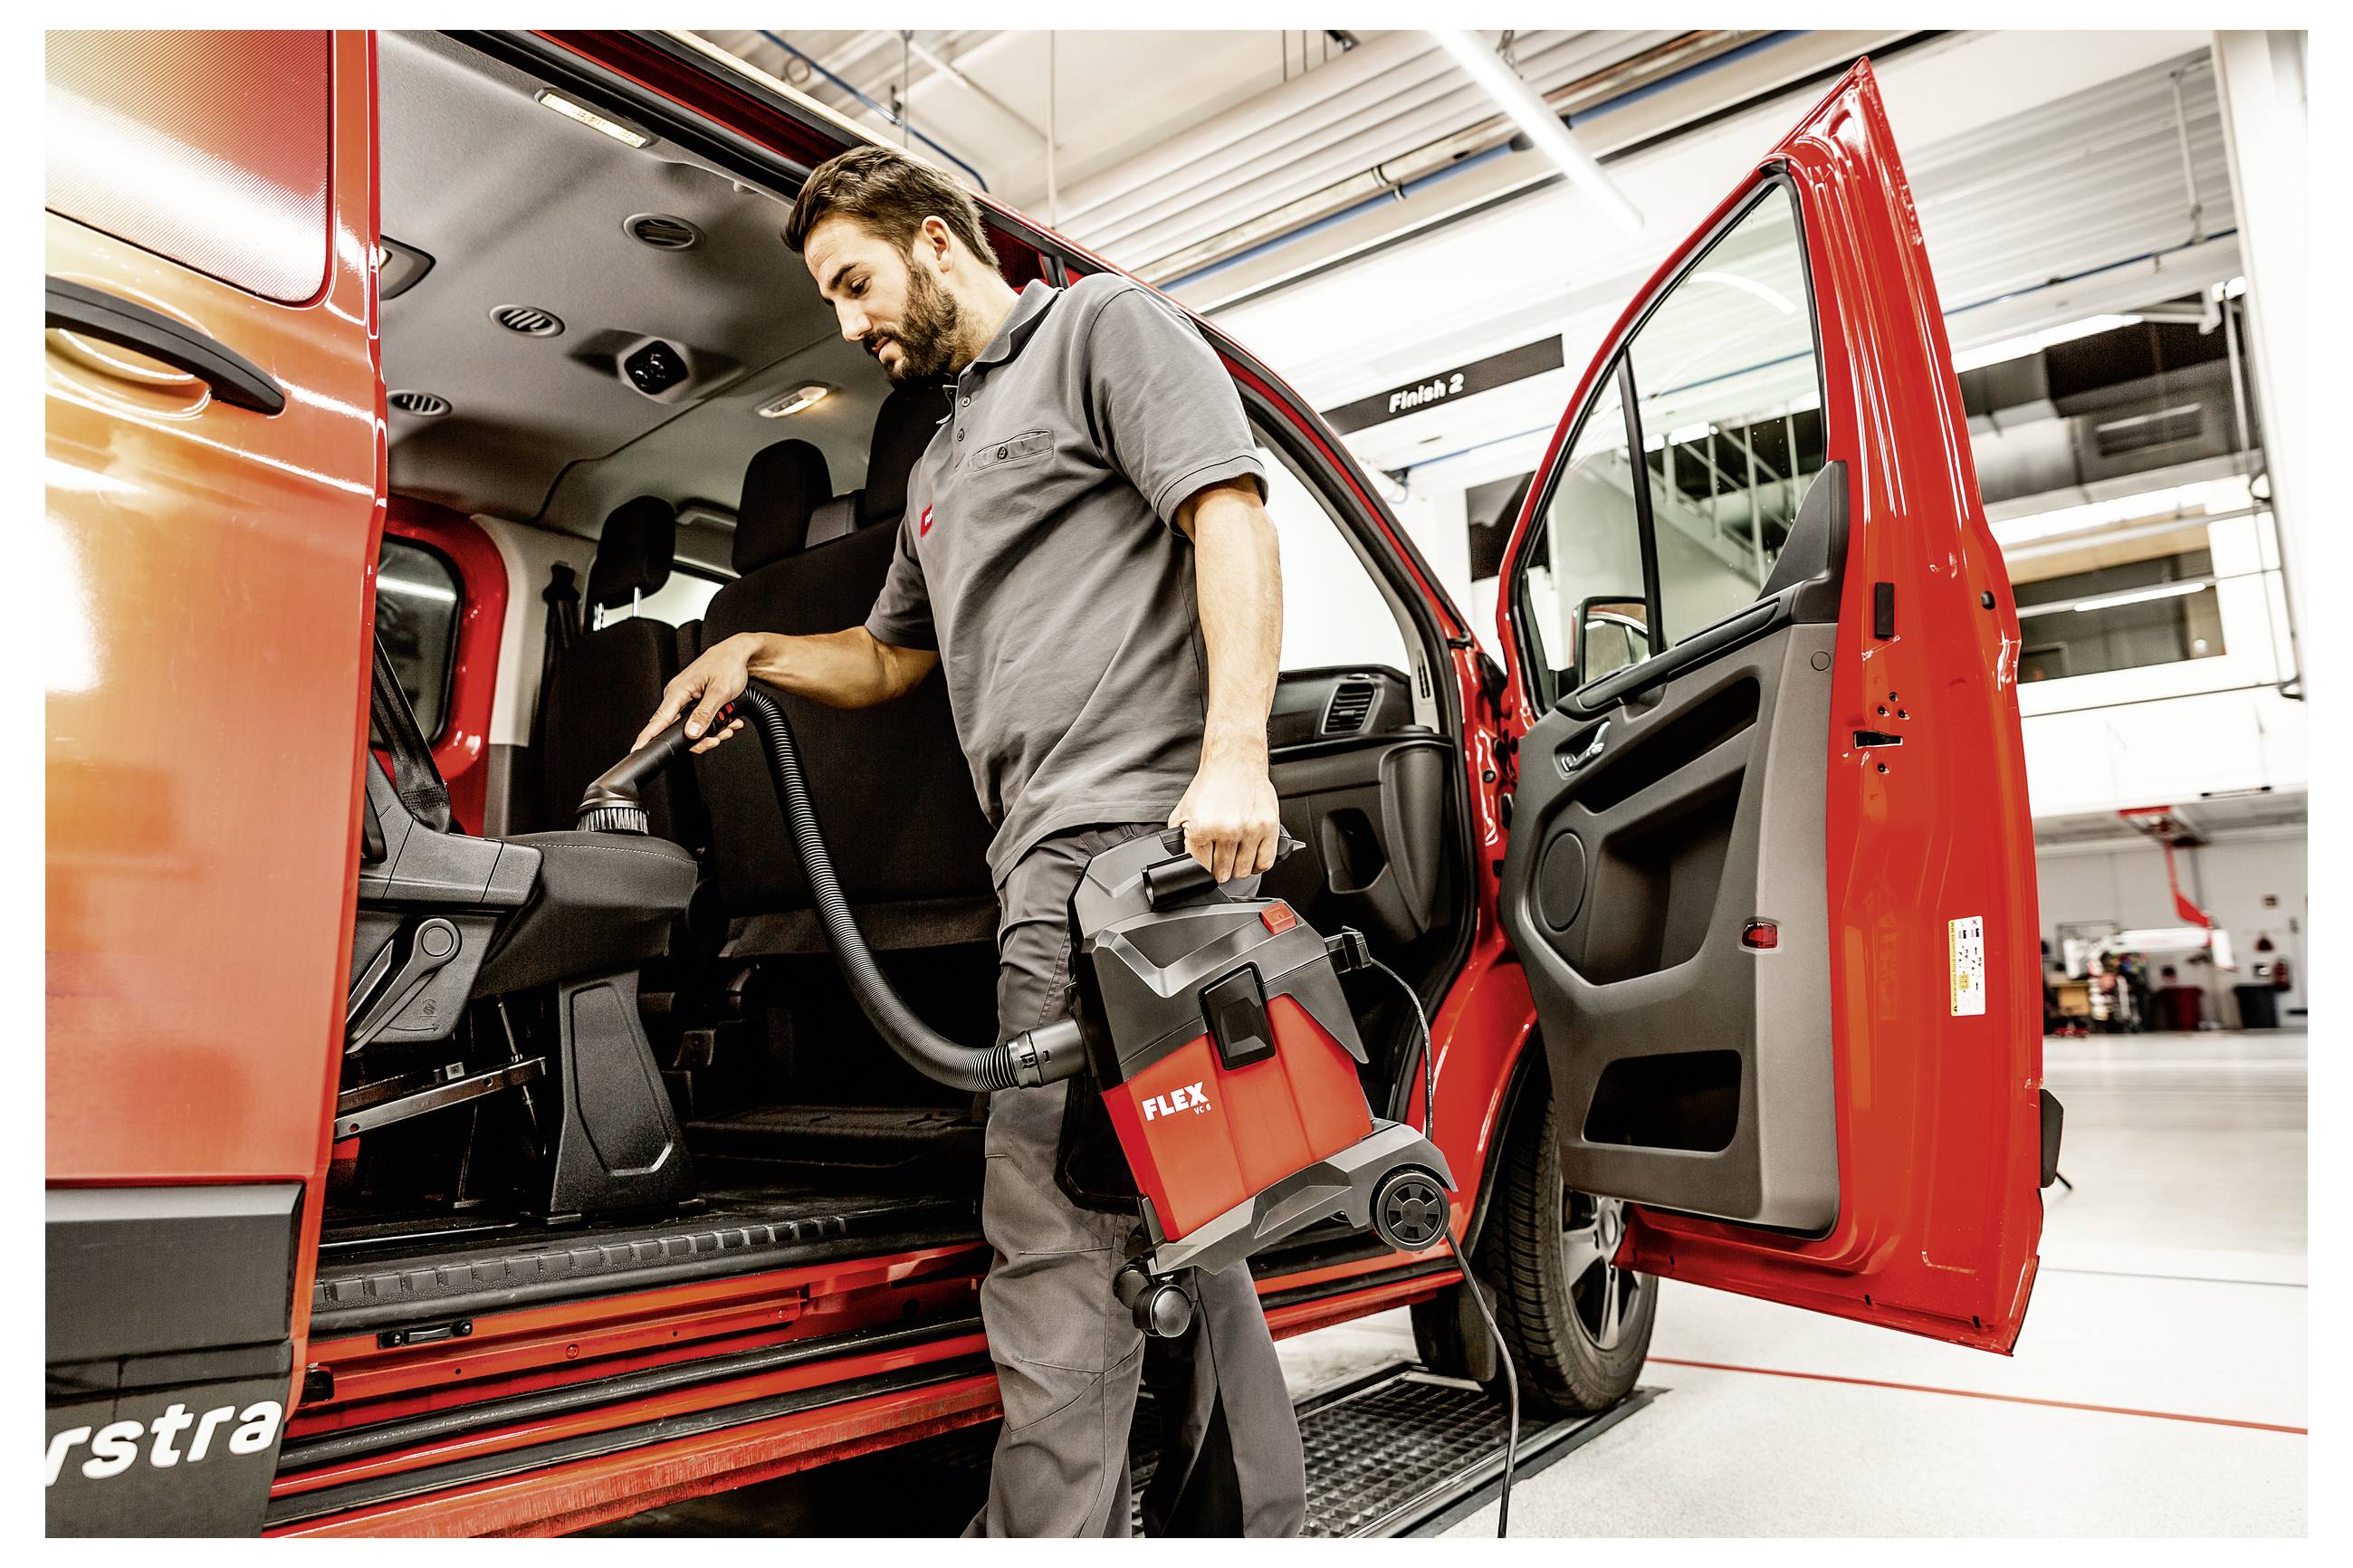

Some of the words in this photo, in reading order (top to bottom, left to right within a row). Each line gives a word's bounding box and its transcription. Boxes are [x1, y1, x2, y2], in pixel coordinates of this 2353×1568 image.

[1389, 378, 1447, 414] Finish
[1449, 372, 1465, 395] 2
[1142, 1081, 1210, 1122] FLEX
[1193, 1105, 1205, 1115] VC
[45, 1401, 282, 1487] rstra
